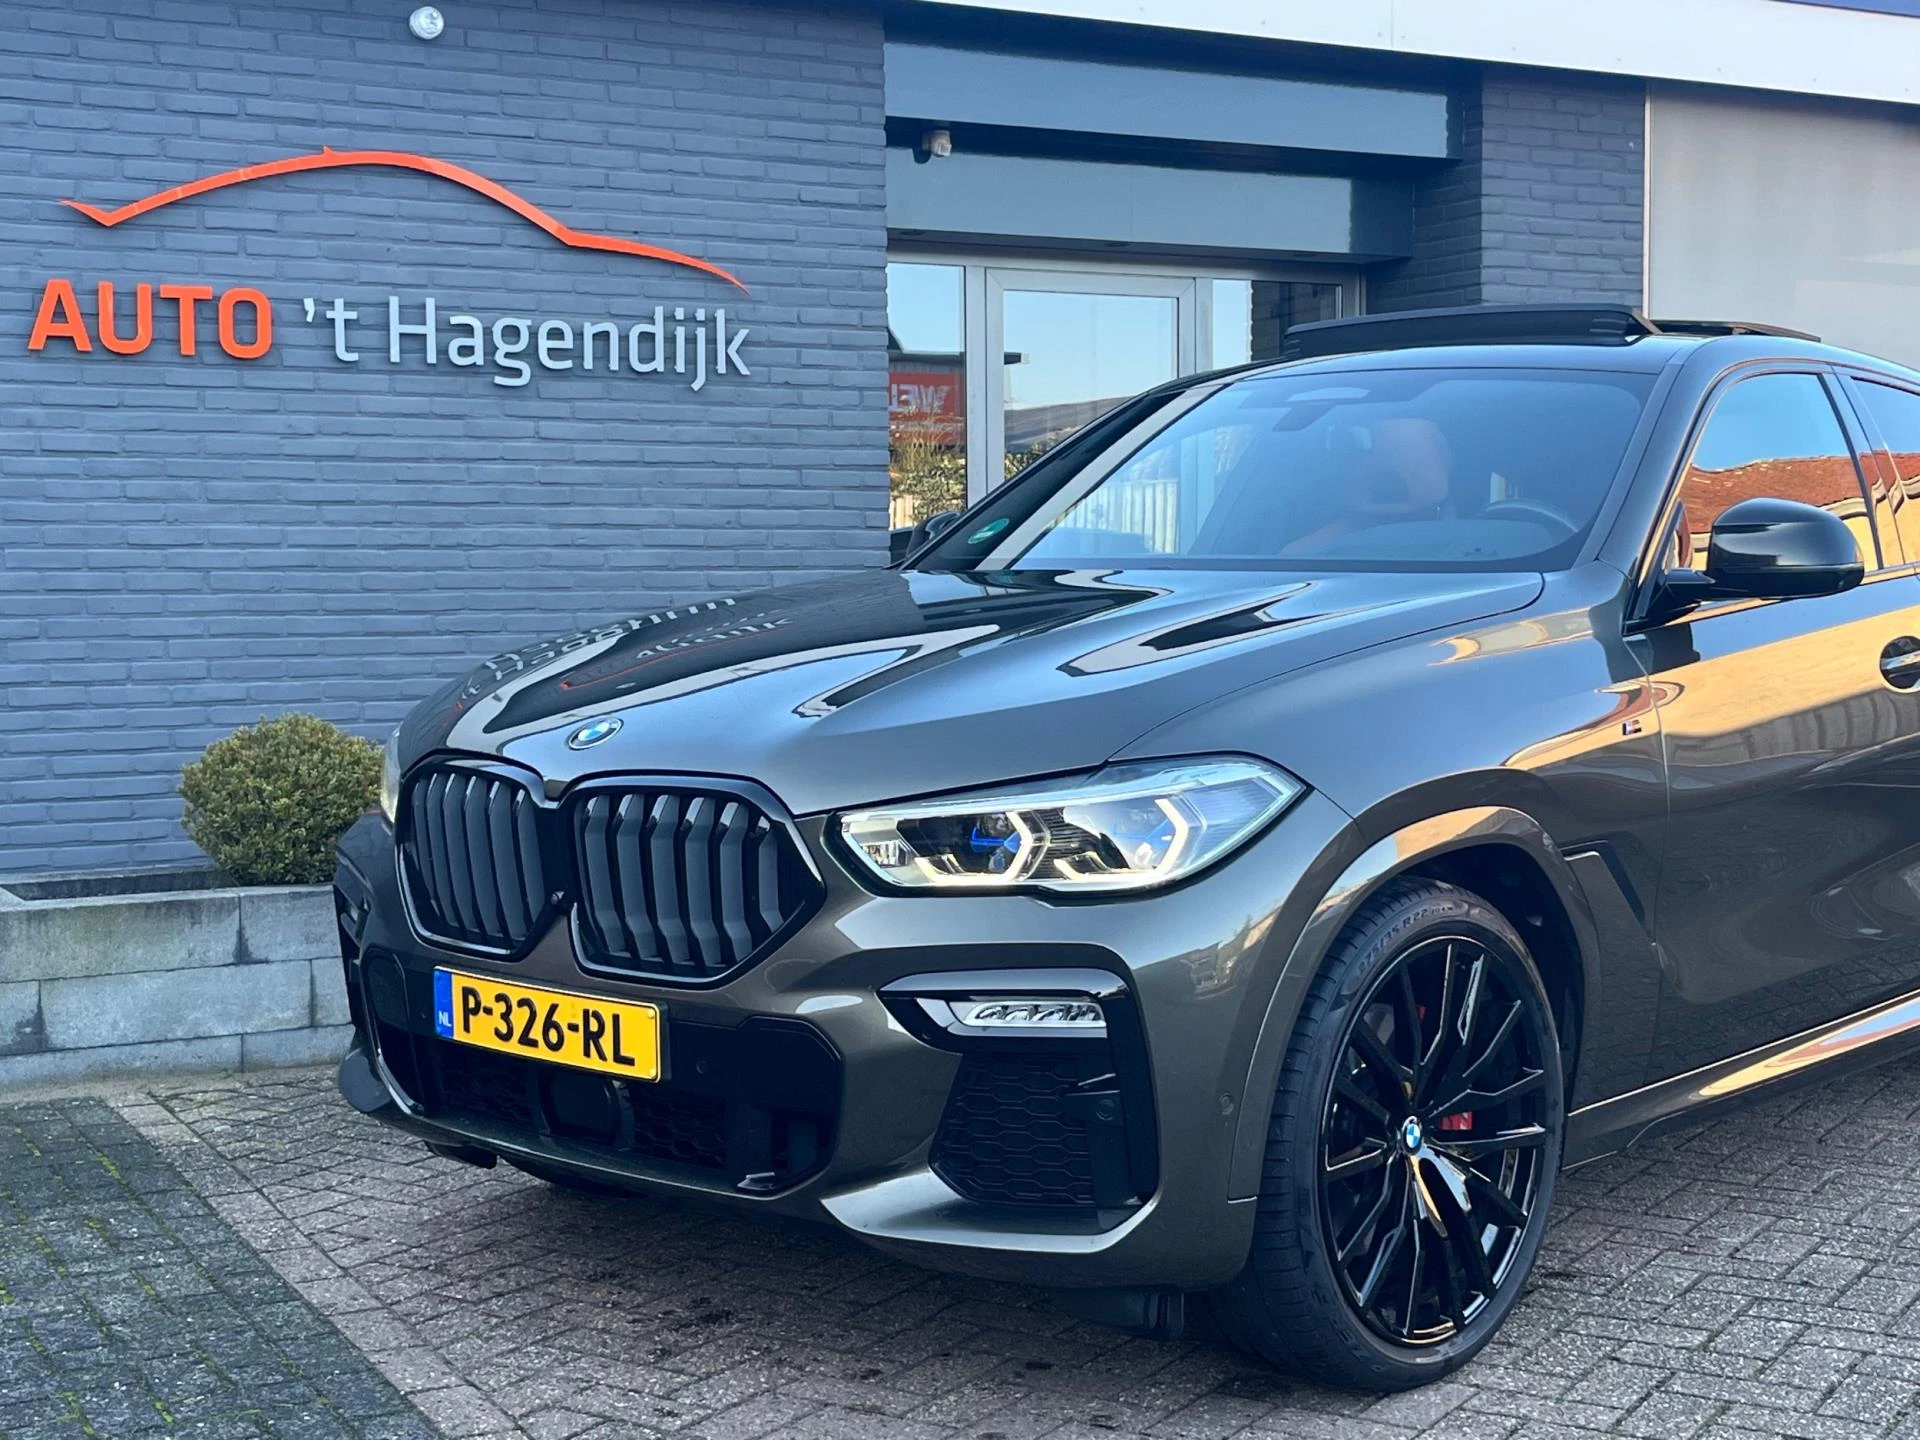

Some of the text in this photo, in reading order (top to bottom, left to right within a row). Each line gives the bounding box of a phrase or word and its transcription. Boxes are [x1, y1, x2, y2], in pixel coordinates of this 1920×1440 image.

[28, 279, 271, 358] AUTO
[389, 295, 751, 391] Hagendijk
[437, 985, 636, 1067] NL P-326-RL
